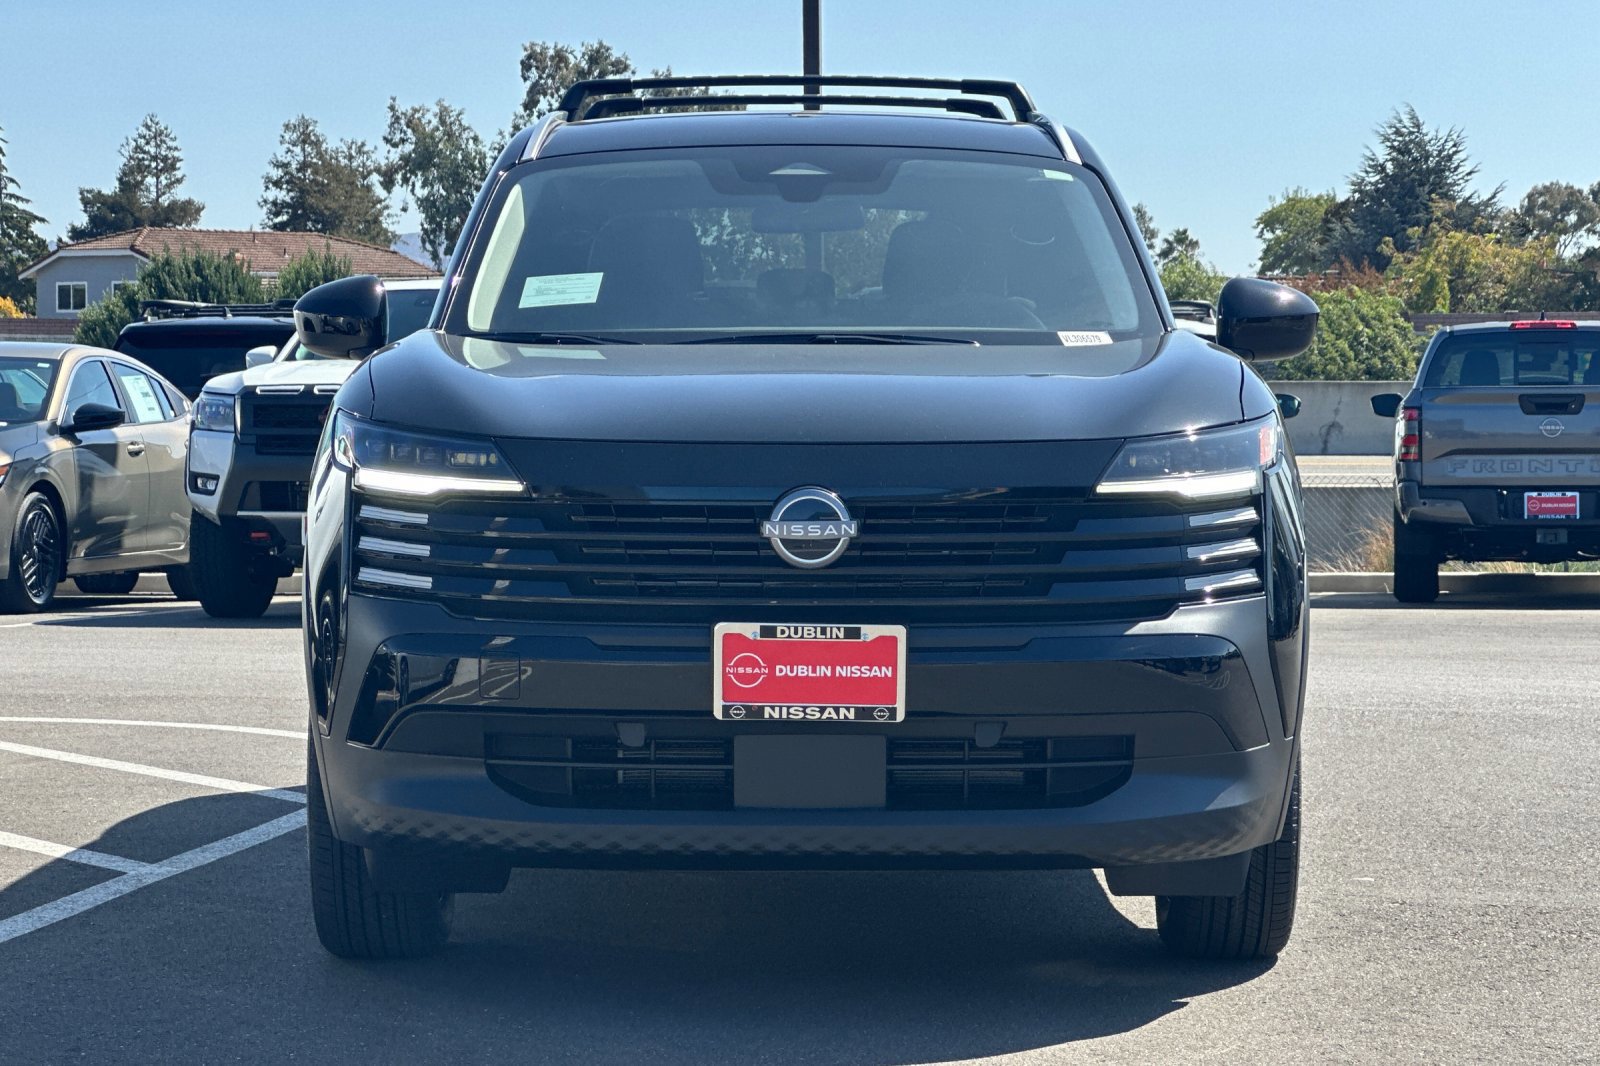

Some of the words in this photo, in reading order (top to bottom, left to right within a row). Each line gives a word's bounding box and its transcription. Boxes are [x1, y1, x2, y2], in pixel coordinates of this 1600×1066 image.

[765, 523, 855, 536] NISSAN
[776, 625, 845, 639] DUBLIN
[726, 666, 769, 674] NISSAN
[775, 665, 832, 677] DUBLIN
[835, 665, 892, 678] NISSAN
[763, 706, 855, 720] NISSAN
